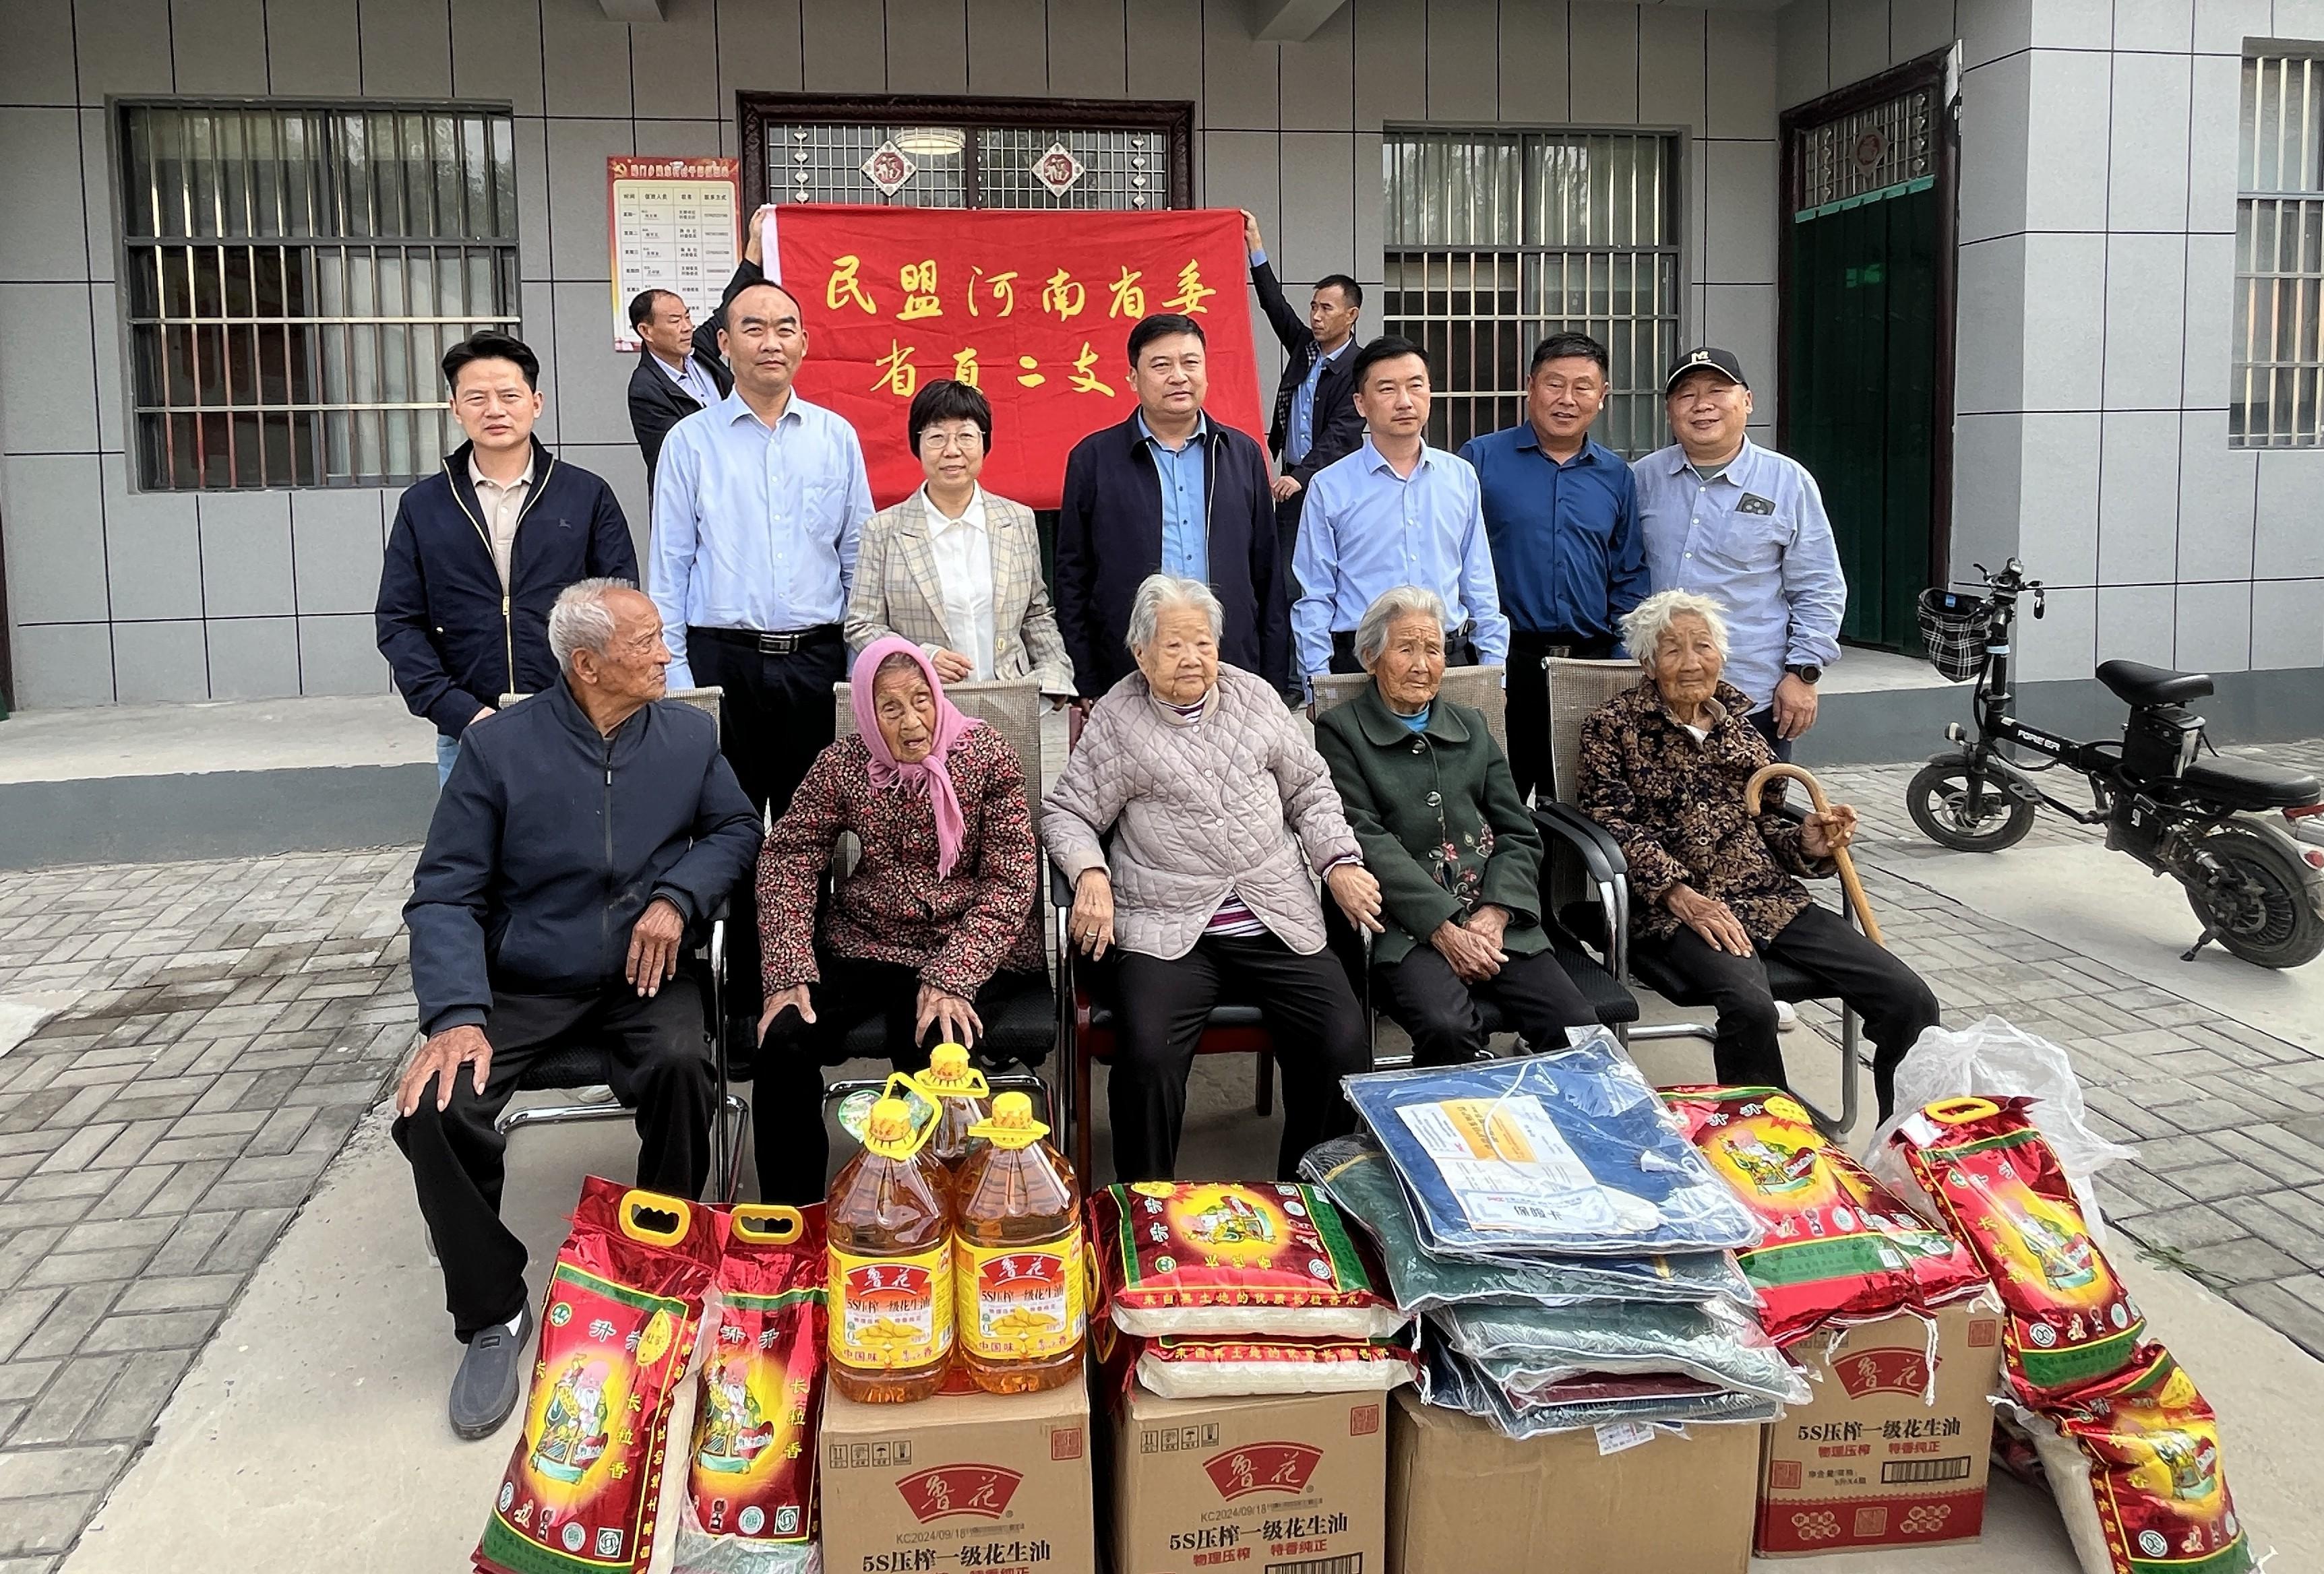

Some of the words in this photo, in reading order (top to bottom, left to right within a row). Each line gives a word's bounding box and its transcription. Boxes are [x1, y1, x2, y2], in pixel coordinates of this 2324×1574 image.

[826, 255, 1217, 321] 民盟河南省委
[870, 340, 1130, 398] 省直二支
[864, 1267, 911, 1288] 鲁花
[999, 1255, 1045, 1278] 鲁花
[1852, 1356, 1920, 1387] 鲁花
[1798, 1416, 1961, 1442] 5S压榨一级花生油
[1225, 1451, 1301, 1488] 鲁花
[921, 1473, 1000, 1510] 鲁花
[1169, 1512, 1348, 1551] 5S压榨一级花生油
[862, 1539, 1051, 1573] 5S压榨一级花生油
[1192, 1547, 1252, 1567] 物理压榨
